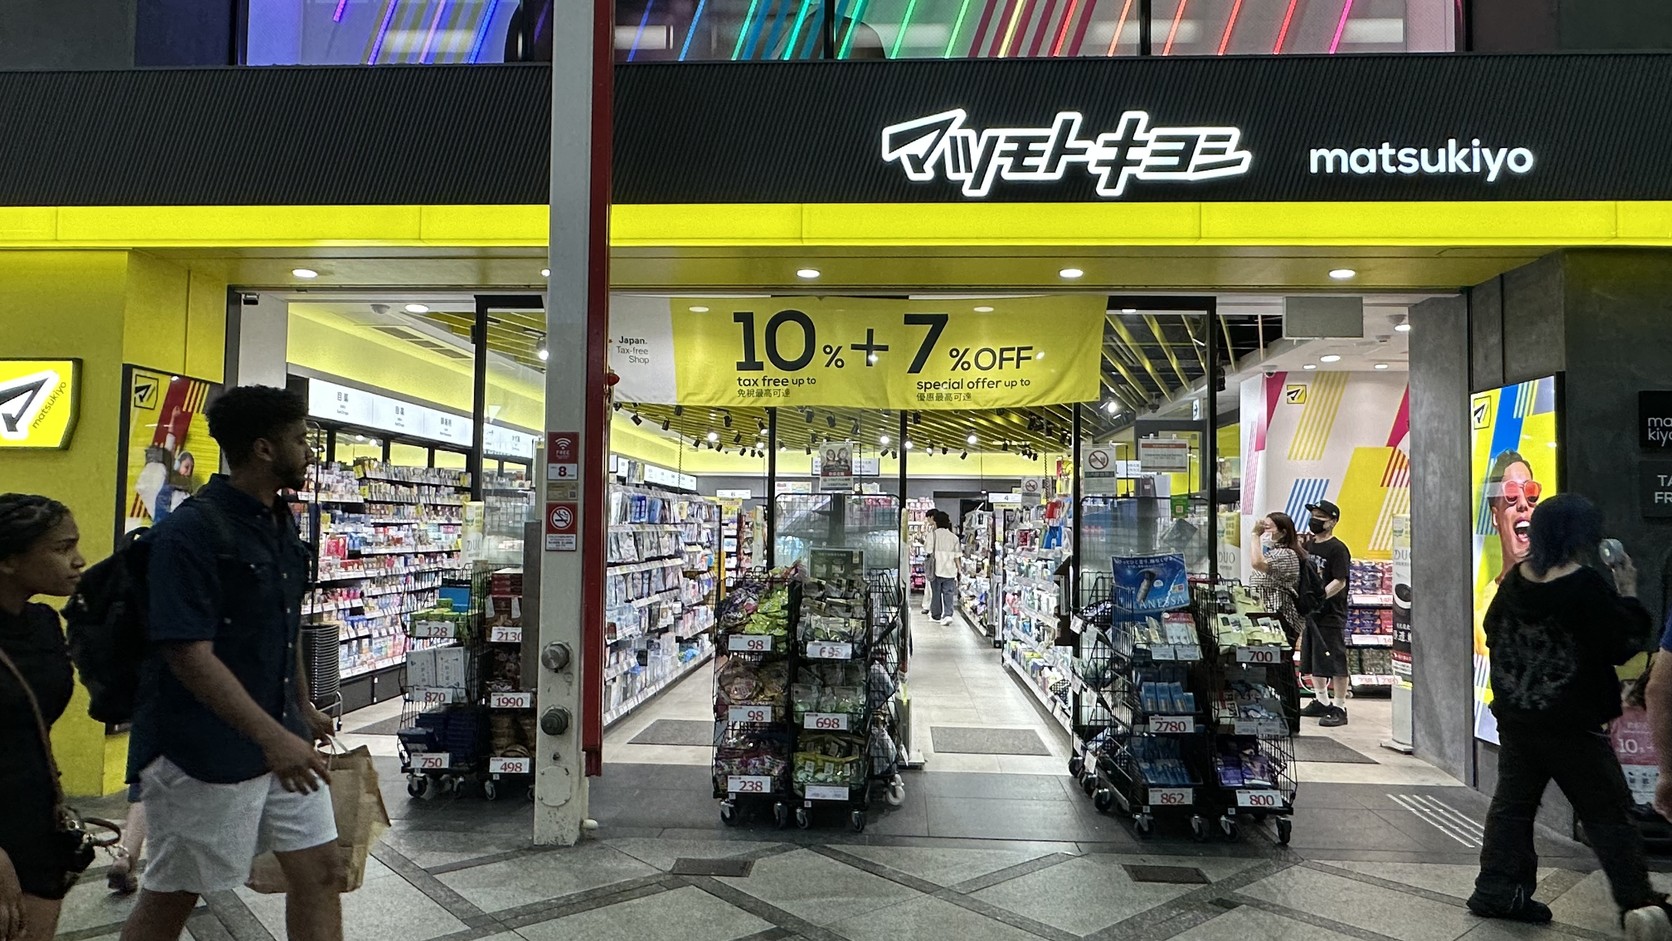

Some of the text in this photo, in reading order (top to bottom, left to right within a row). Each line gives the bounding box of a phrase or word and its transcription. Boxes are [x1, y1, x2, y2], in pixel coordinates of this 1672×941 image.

[1309, 138, 1534, 182] matsukiyo
[616, 345, 649, 355] Tax-free
[628, 354, 650, 365] Shop
[736, 375, 817, 387] tax free up to
[916, 377, 1031, 392] special offer up to
[33, 381, 68, 429] matsukiyo
[558, 466, 567, 477] 8
[1139, 595, 1185, 609] ANESSA
[426, 626, 448, 637] 128
[747, 639, 764, 650] 98
[1248, 650, 1273, 662] 700
[424, 692, 446, 702] 870
[496, 697, 524, 707] 1990
[747, 710, 764, 721] 98
[815, 717, 840, 729] 698
[1154, 720, 1187, 731] 2780
[421, 757, 443, 768] 750
[500, 762, 523, 772] 498
[739, 781, 763, 792] 238
[1160, 793, 1185, 804] 862
[1249, 794, 1275, 806] 800
